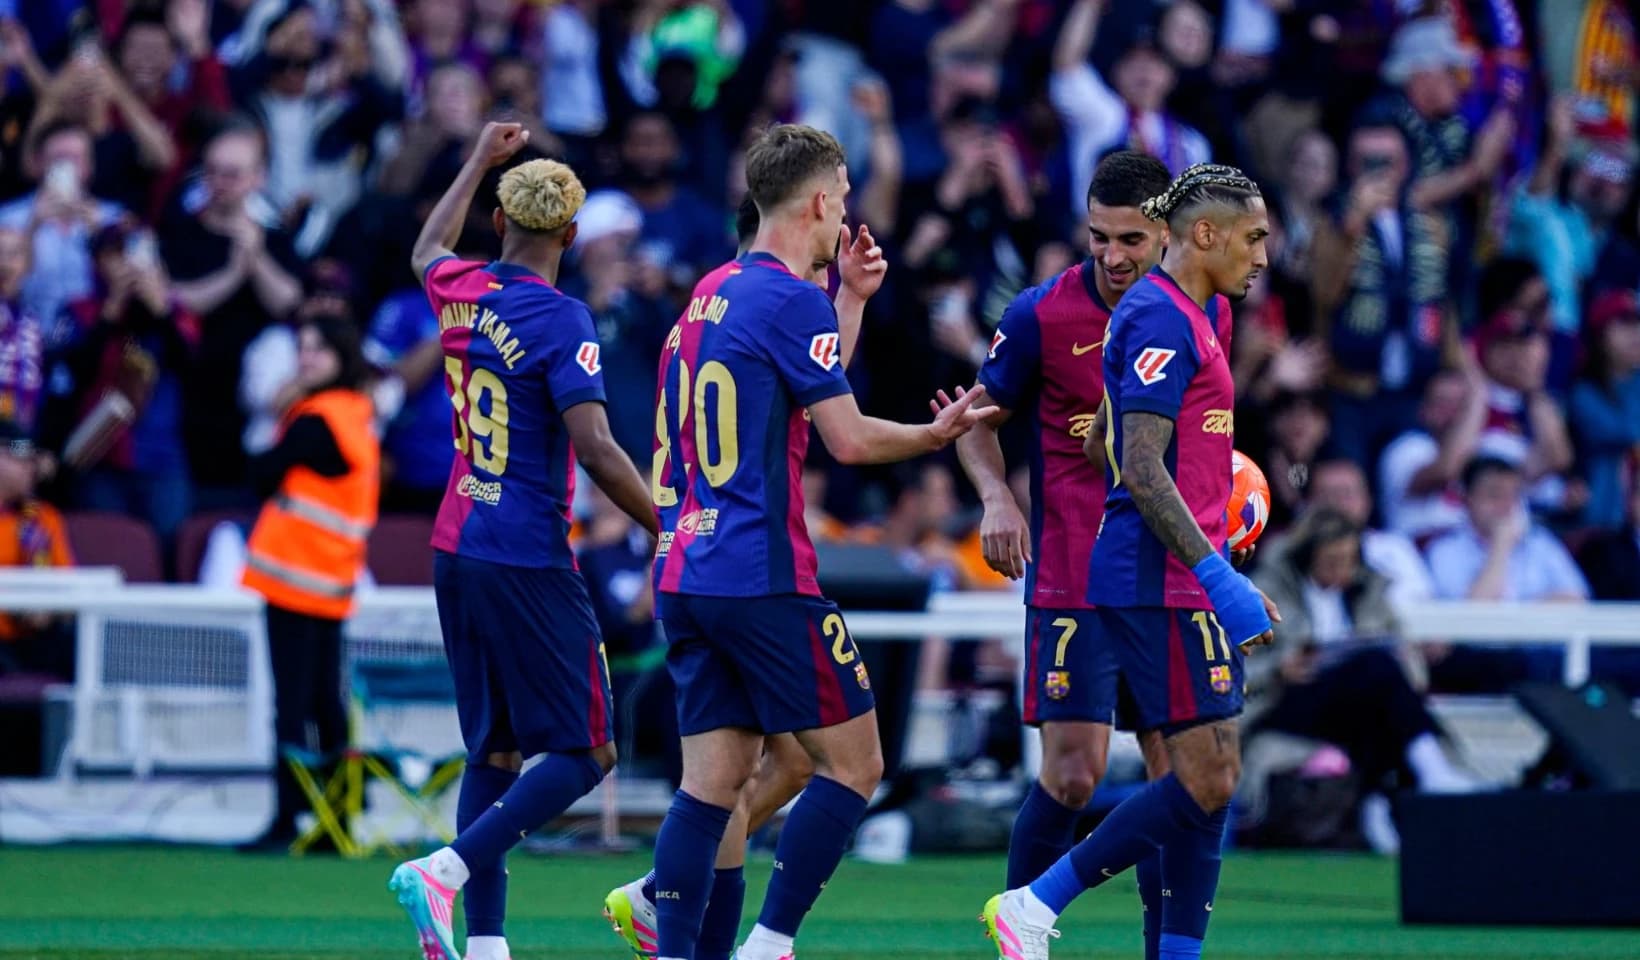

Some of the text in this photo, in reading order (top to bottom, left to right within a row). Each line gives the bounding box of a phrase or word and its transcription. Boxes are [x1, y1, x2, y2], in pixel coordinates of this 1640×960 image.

[687, 295, 728, 325] OLMO
[477, 308, 526, 370] YAMAL
[1051, 617, 1078, 667] 7
